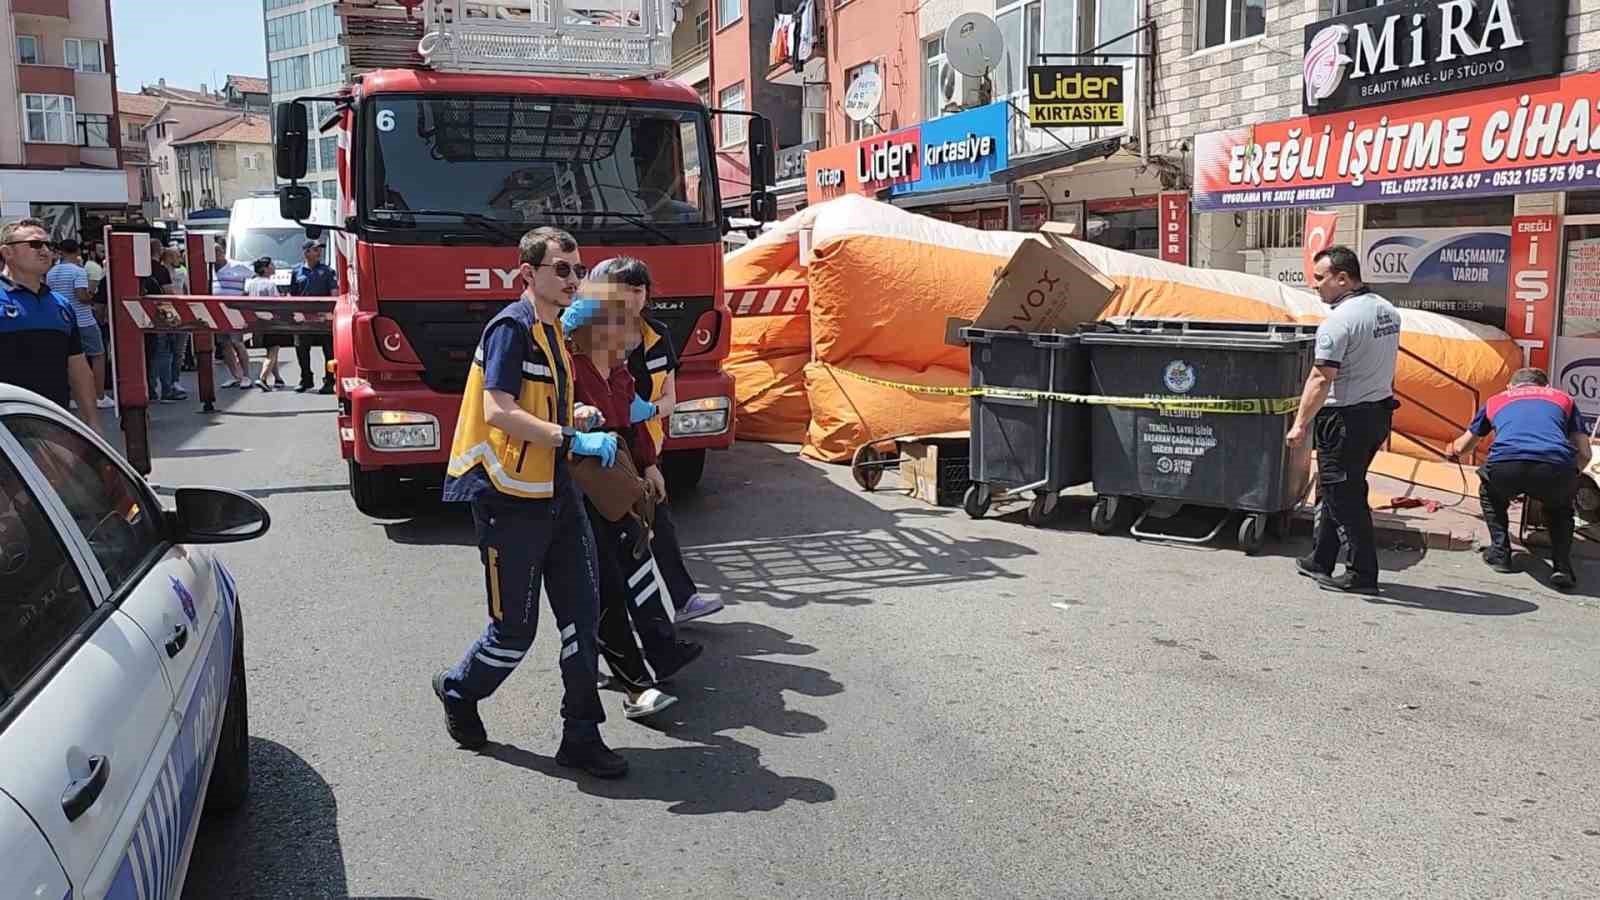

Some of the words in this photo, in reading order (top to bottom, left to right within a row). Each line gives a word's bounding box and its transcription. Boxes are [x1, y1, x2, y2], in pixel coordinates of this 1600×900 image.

[1033, 72, 1119, 100] Lider
[1361, 79, 1399, 97] BEAUTY
[1401, 73, 1431, 89] MAKE
[1440, 68, 1455, 82] UP
[376, 109, 396, 132] 6
[857, 139, 916, 182] Lider
[1228, 124, 1333, 185] EREĞLİ
[1339, 115, 1471, 186] İŞİTME
[815, 166, 842, 189] kitap
[1403, 178, 1427, 193] 0372
[1430, 177, 1448, 191] 316
[1450, 176, 1465, 190] 24
[1466, 174, 1480, 188] 67
[1492, 170, 1521, 186] 0532
[1525, 168, 1546, 184] 155
[1549, 166, 1566, 182] 75
[1567, 163, 1585, 181] 98
[1262, 191, 1272, 203] VE
[1274, 189, 1295, 204] SATIŞ
[1296, 186, 1335, 201] MERKEZİ
[1373, 252, 1409, 274] SGK
[1440, 248, 1505, 266] ANLAŞMAMIZ
[1278, 269, 1306, 282] otico
[1452, 267, 1489, 282] VARDIR
[1568, 374, 1600, 399] SG
